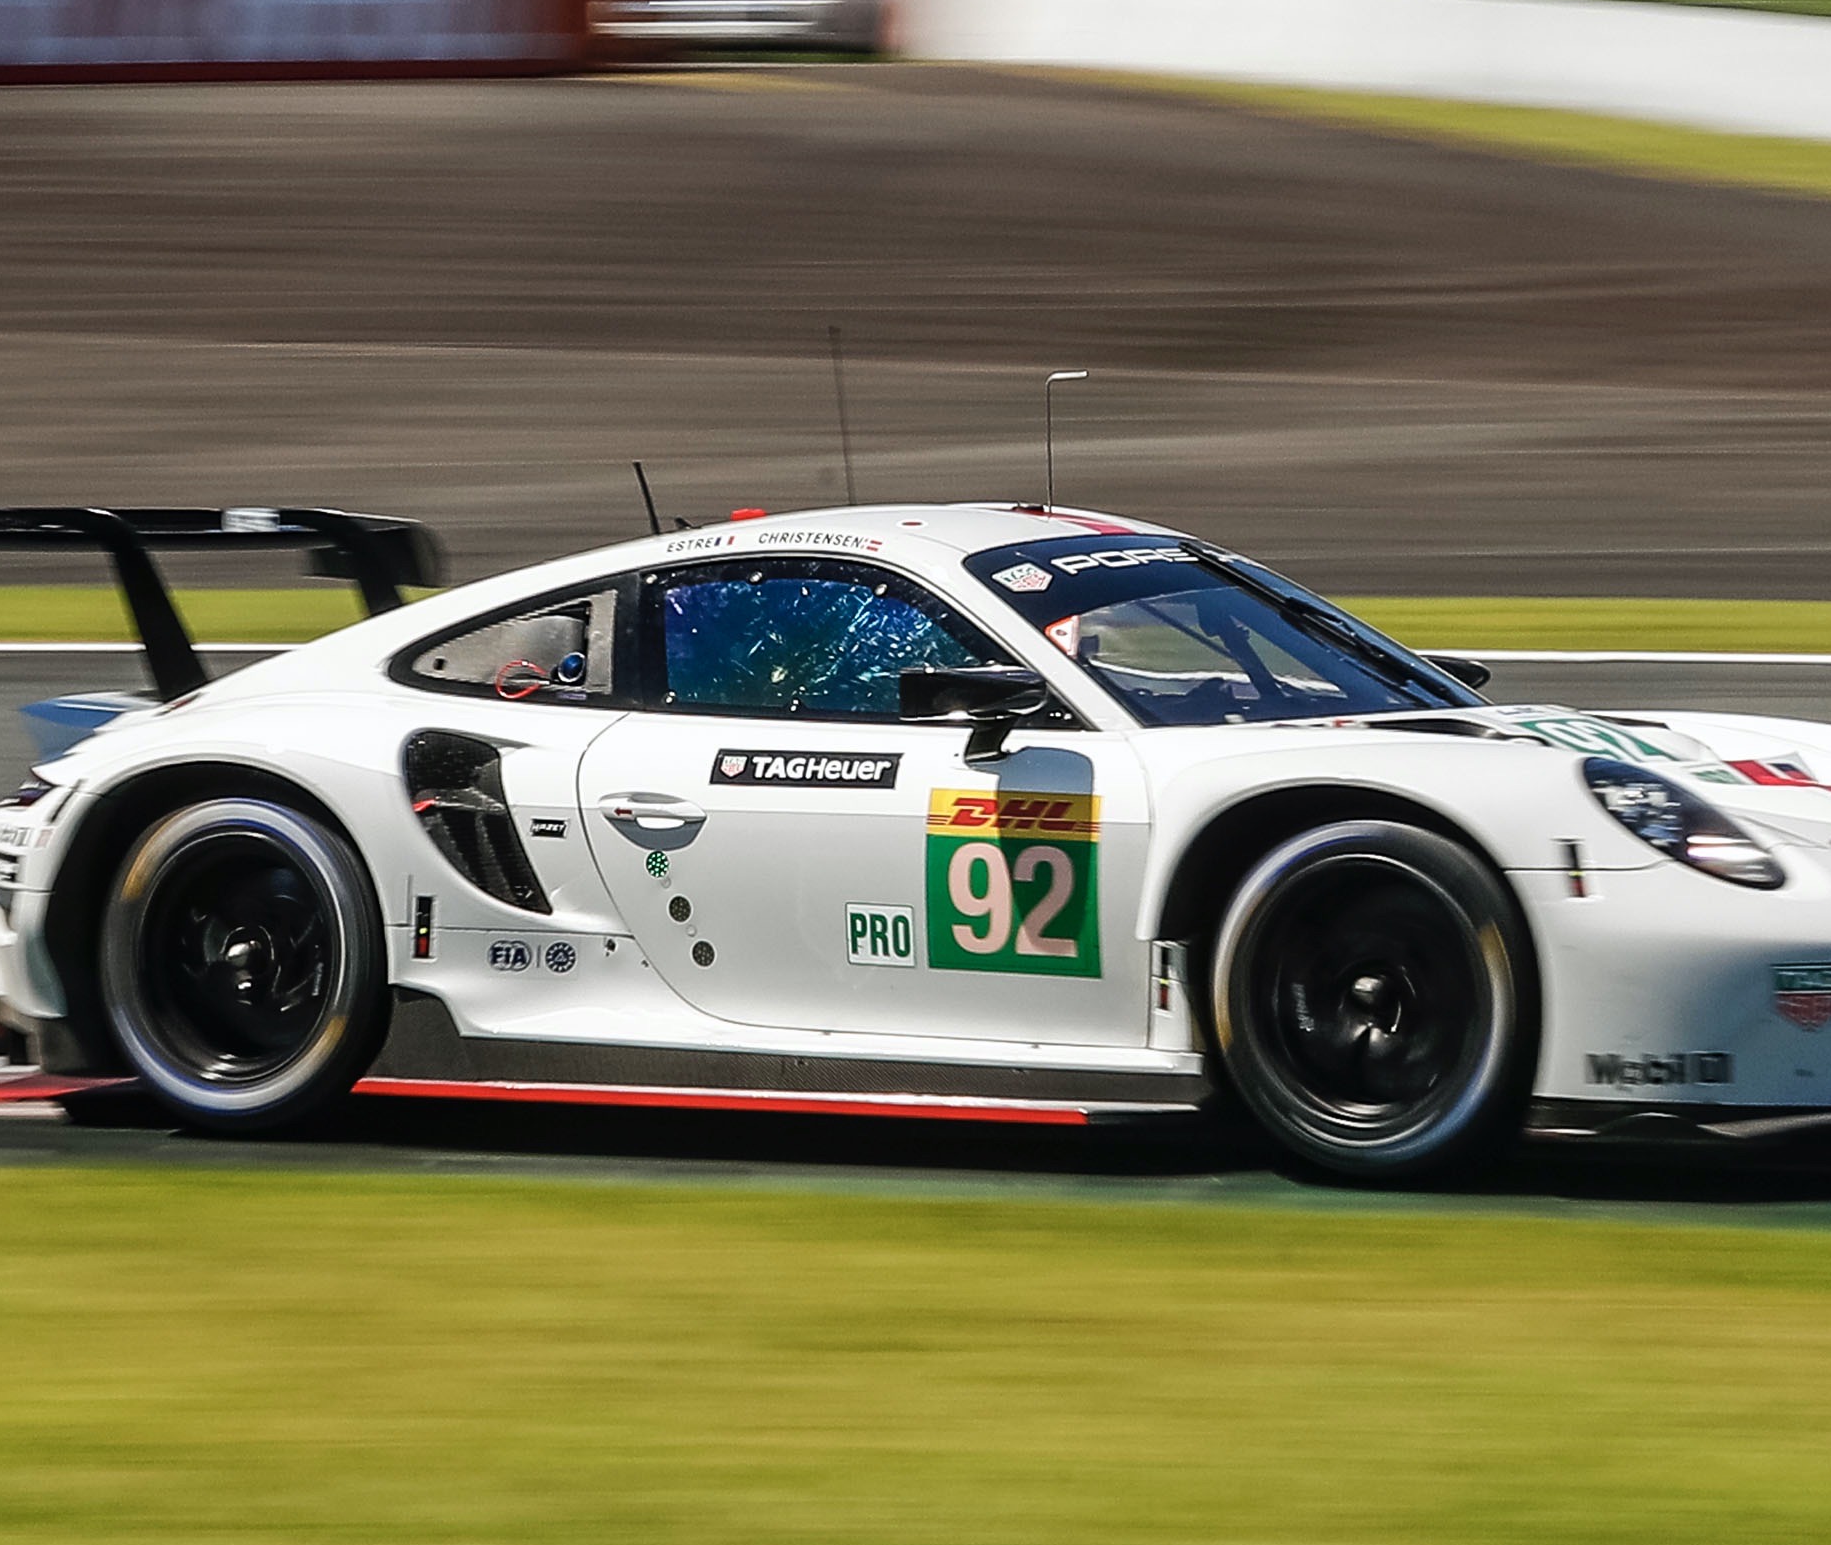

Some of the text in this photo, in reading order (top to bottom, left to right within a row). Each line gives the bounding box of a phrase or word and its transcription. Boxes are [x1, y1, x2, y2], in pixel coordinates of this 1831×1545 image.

[667, 536, 715, 553] ESTRE
[758, 532, 865, 549] CHRISTENSEN
[949, 797, 1075, 831] DHL
[948, 842, 1078, 957] 92
[850, 913, 912, 957] PRO
